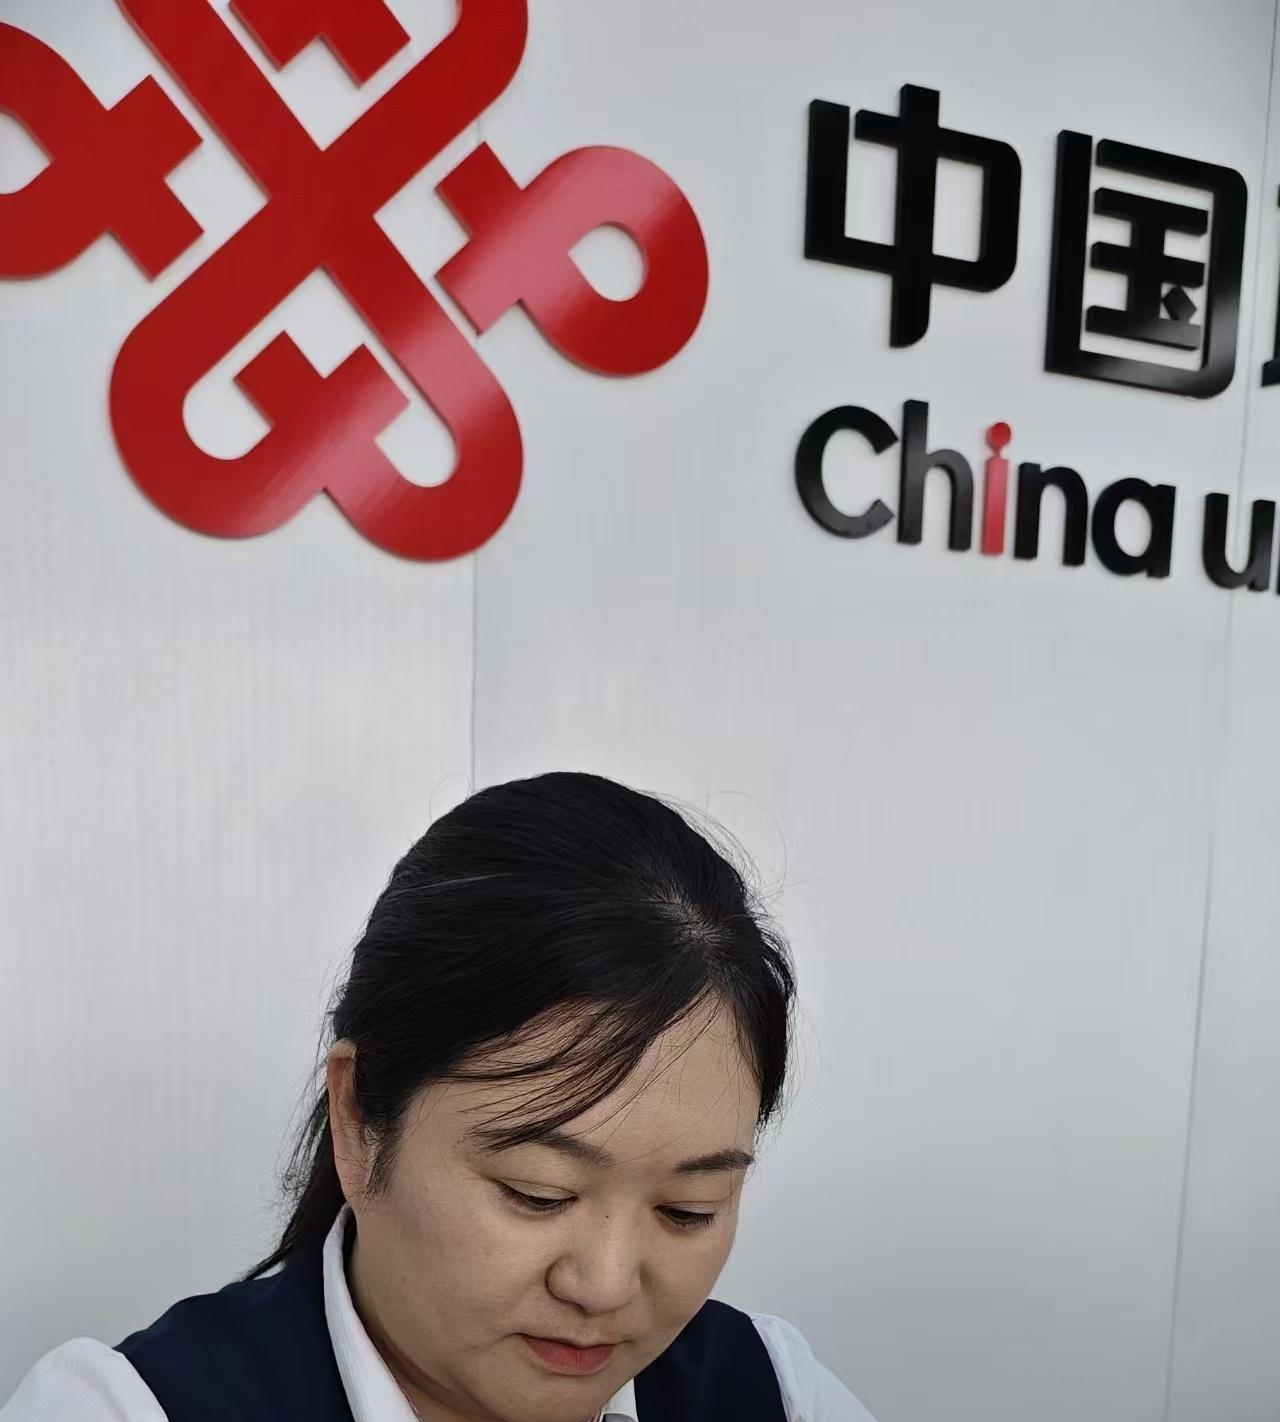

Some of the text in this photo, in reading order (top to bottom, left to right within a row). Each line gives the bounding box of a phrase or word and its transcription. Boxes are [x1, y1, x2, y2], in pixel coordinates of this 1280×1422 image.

[804, 84, 1280, 400] 中国
[794, 399, 1280, 597] China u
